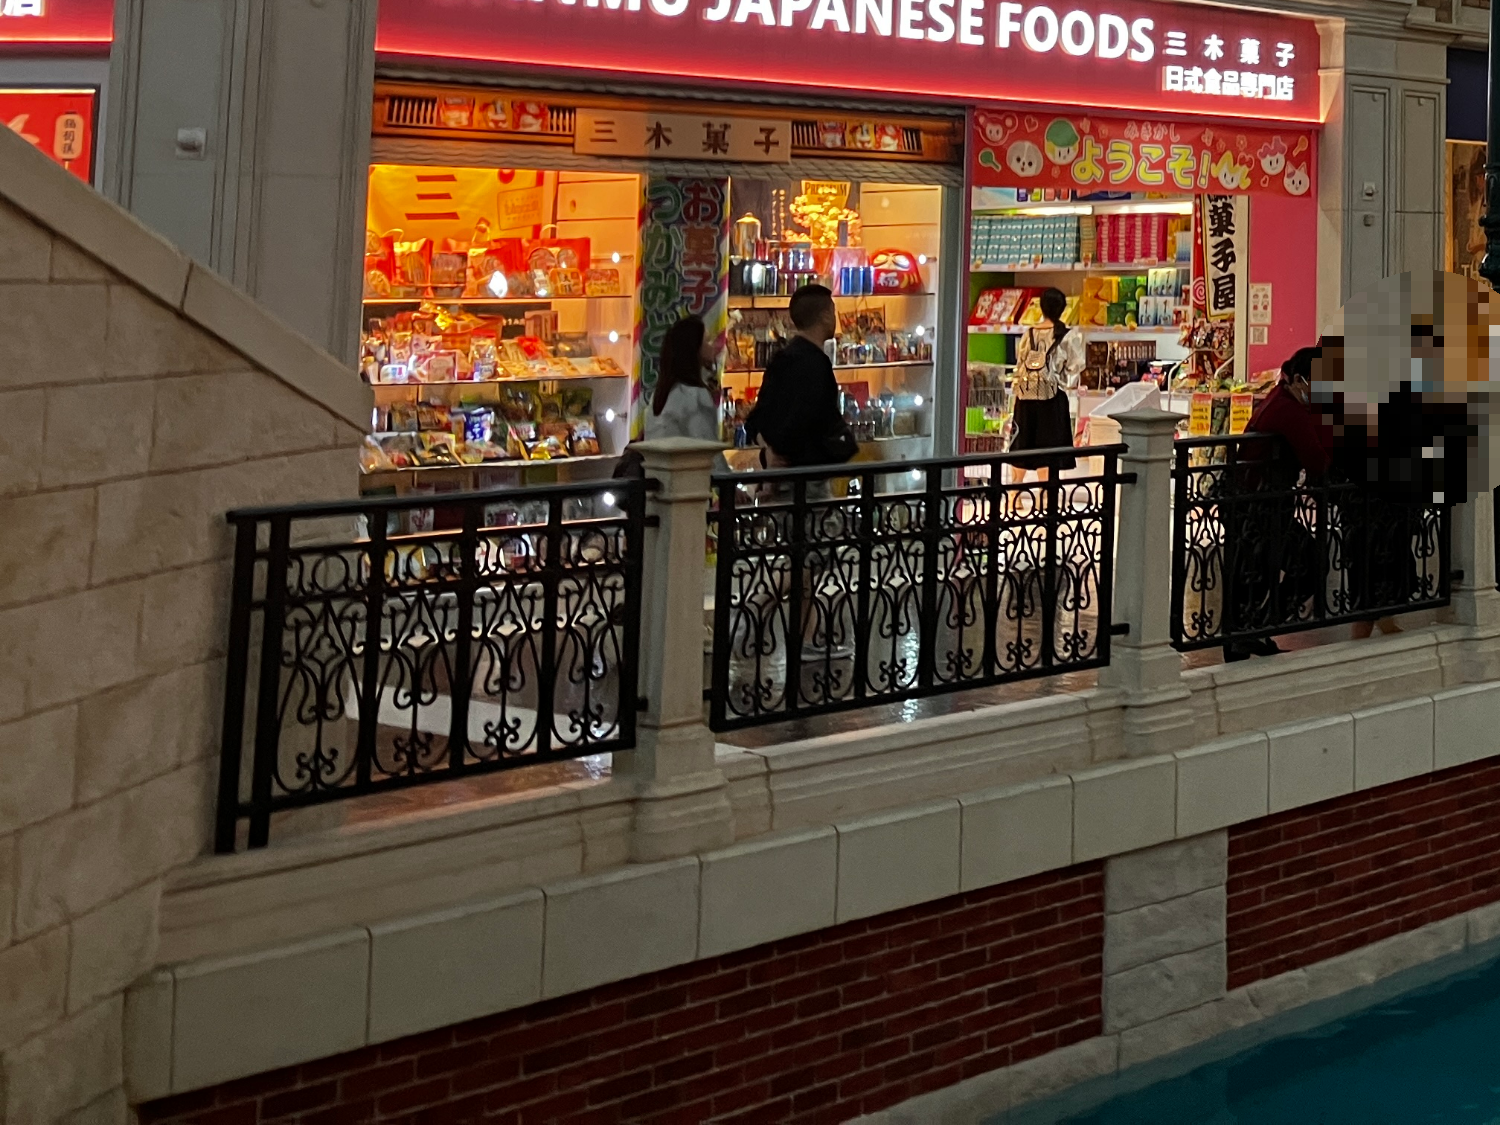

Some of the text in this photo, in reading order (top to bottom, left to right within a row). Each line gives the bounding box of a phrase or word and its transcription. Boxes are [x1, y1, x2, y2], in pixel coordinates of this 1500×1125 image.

[995, 1, 1156, 63] FOODS
[1163, 31, 1295, 67] 三木菓子
[590, 120, 780, 156] 三木菓子
[681, 180, 721, 315] お菓子
